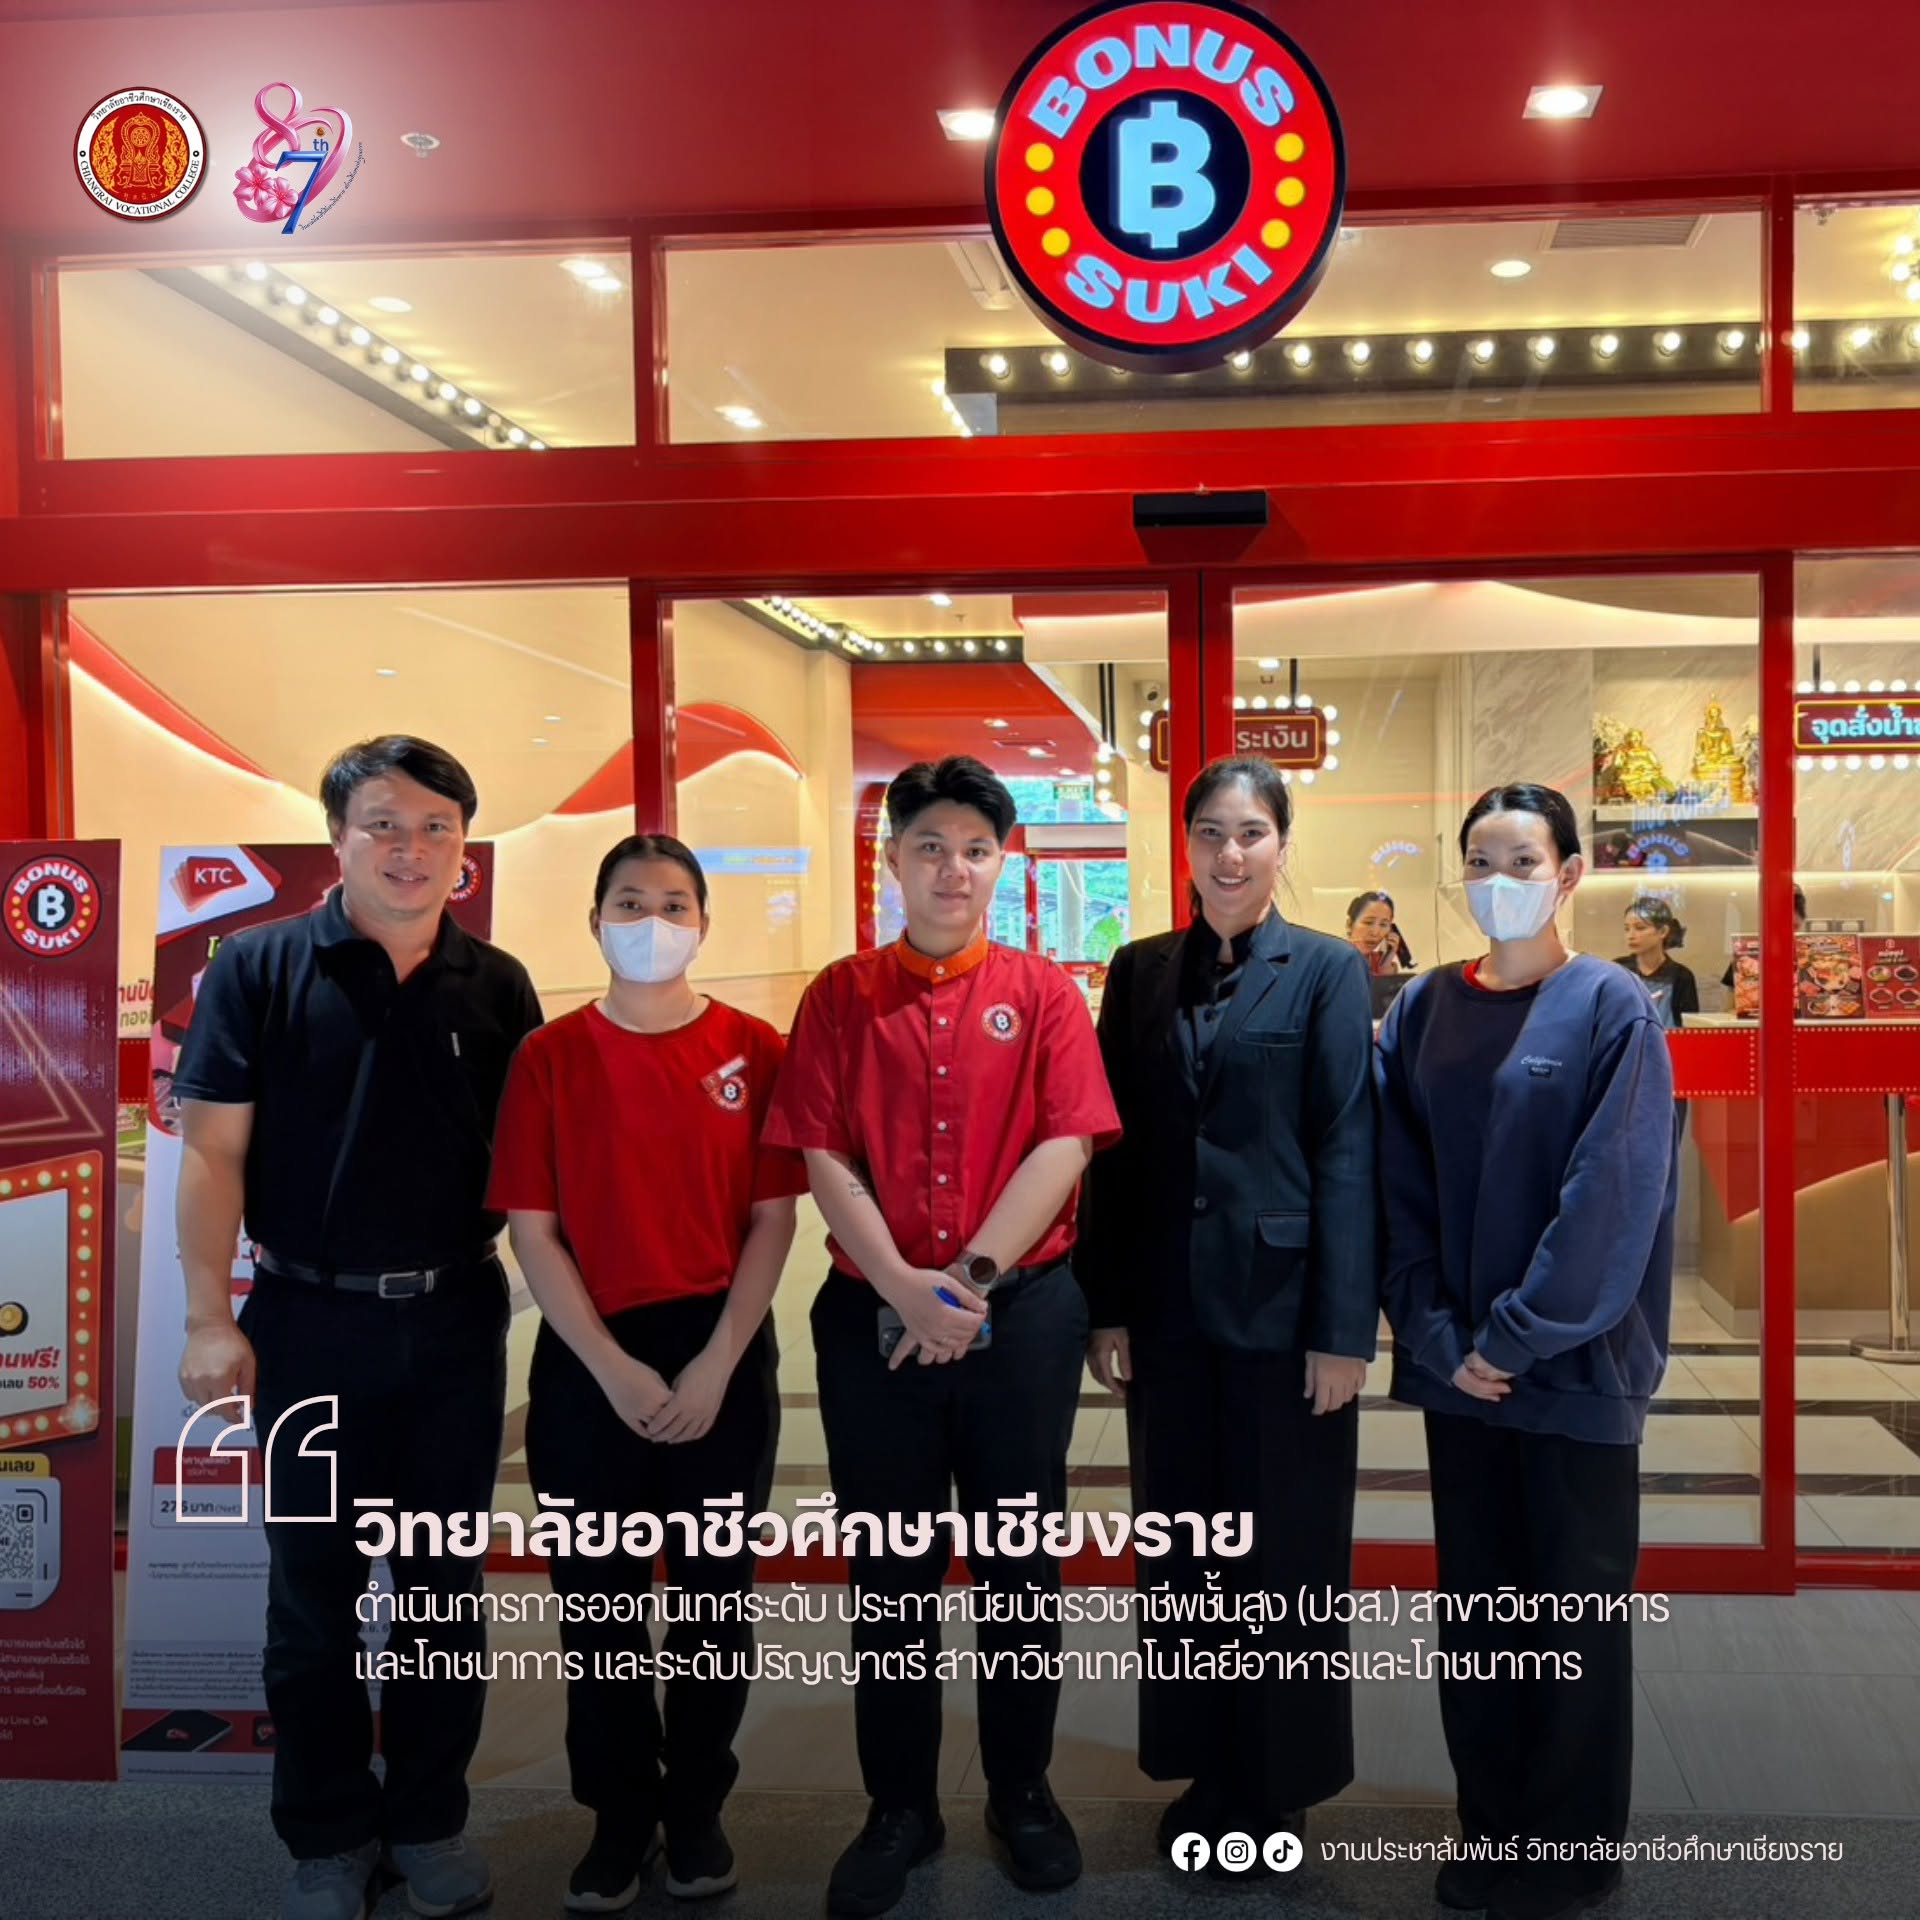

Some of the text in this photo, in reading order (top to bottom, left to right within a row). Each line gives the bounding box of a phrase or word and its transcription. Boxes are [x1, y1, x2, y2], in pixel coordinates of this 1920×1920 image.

[1028, 24, 1295, 138] BONUS
[1064, 243, 1273, 323] SUKI
[13, 862, 89, 895] BONUS
[194, 867, 233, 884] KTC
[22, 926, 81, 950] SUKI
[27, 1376, 60, 1389] 50%
